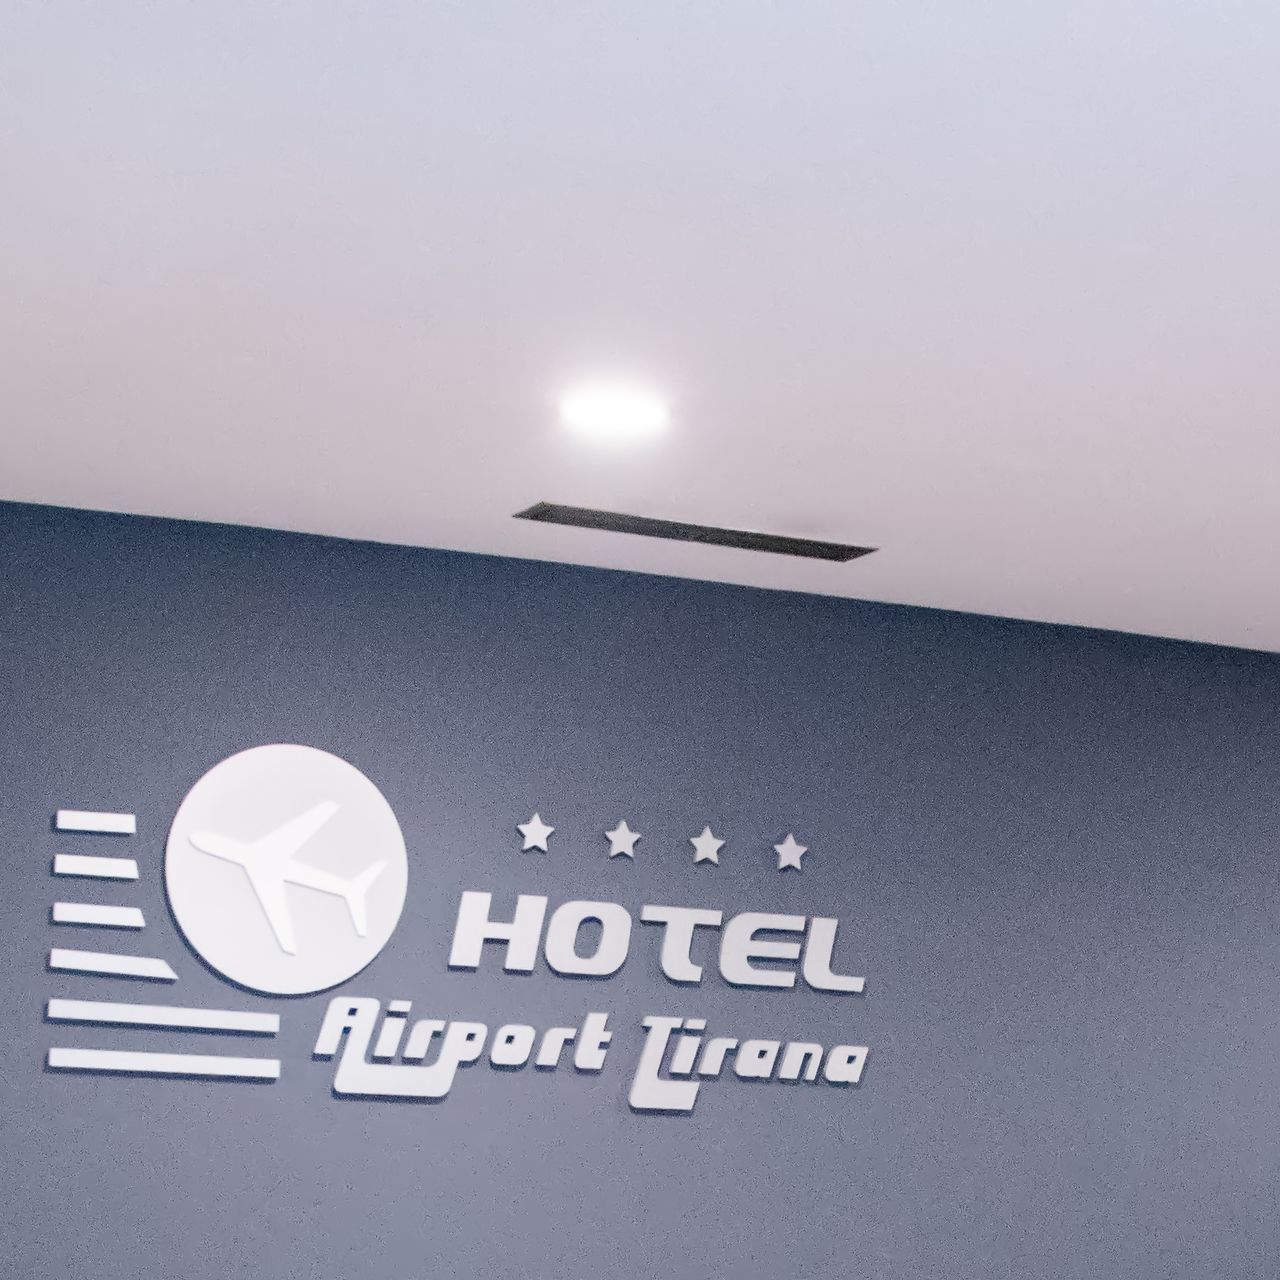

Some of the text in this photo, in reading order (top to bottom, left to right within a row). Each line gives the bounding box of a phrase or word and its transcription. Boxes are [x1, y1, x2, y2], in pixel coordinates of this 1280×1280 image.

[448, 890, 866, 993] HOTEL
[312, 996, 869, 1111] Airport Tirana
